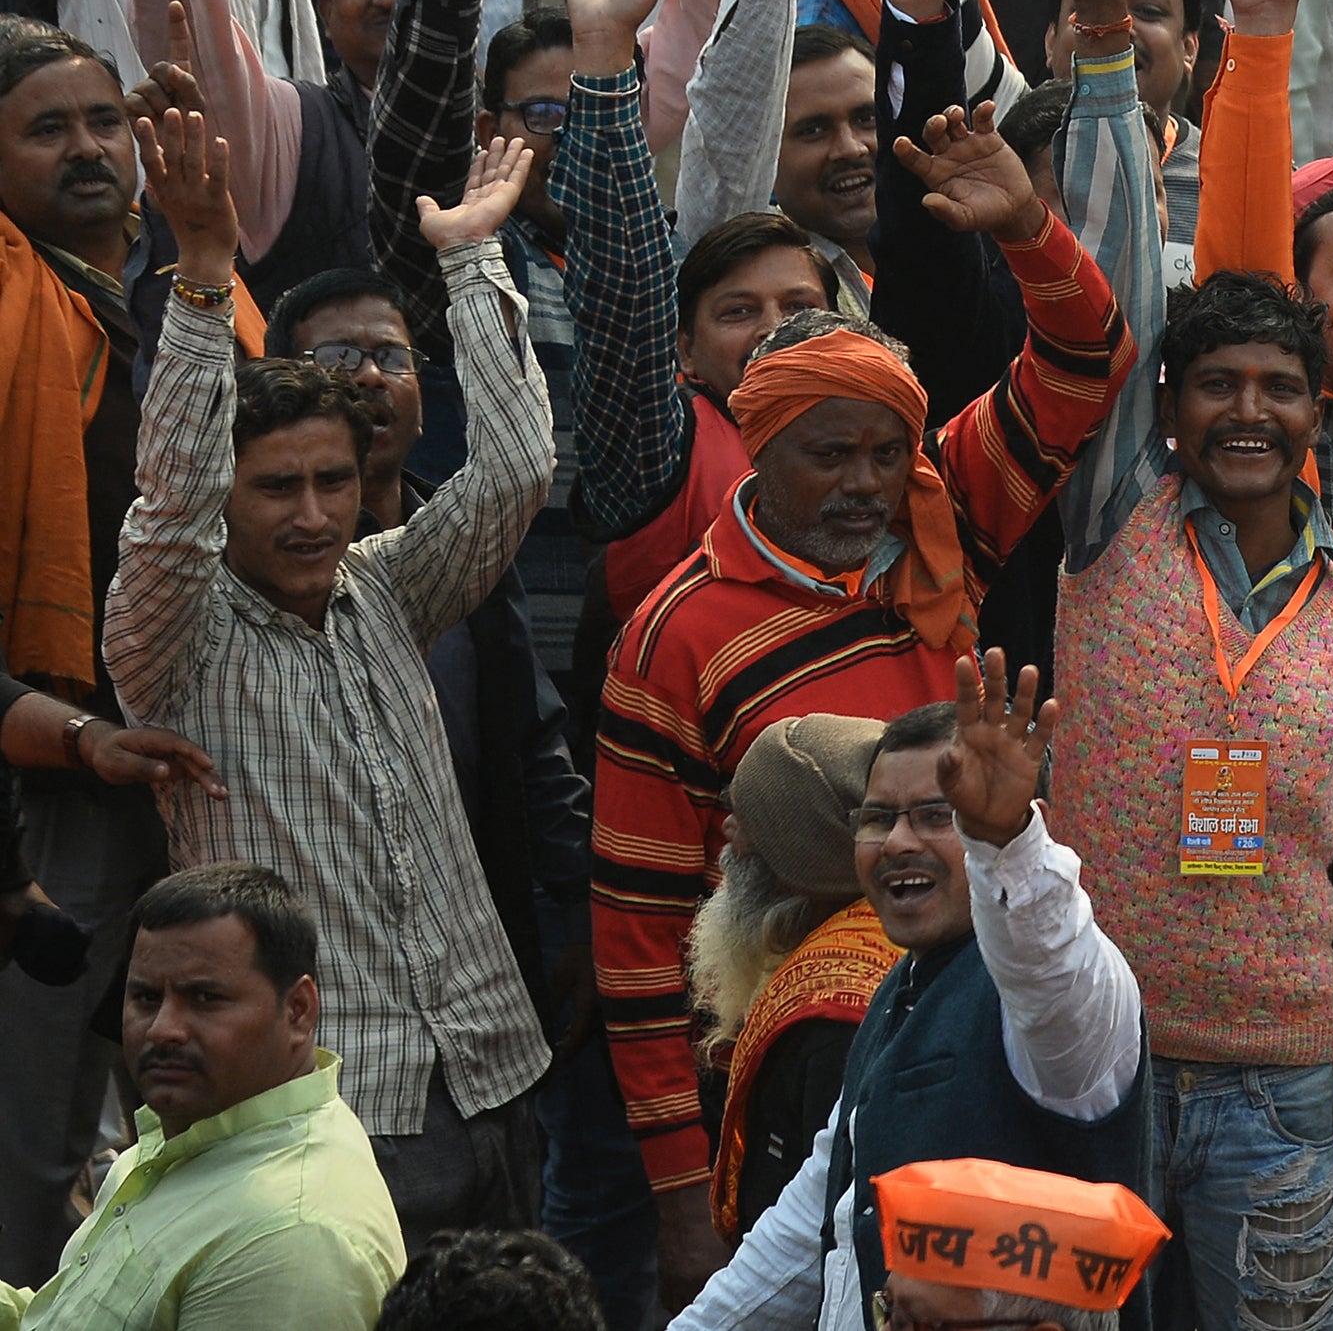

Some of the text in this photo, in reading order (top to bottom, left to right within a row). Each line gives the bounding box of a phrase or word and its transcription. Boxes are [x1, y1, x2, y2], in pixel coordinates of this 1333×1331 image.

[1174, 254, 1192, 272] ck
[1188, 812, 1259, 834] विशाल धर्म सभा
[896, 1219, 975, 1268] जय
[990, 1222, 1058, 1281] श्री
